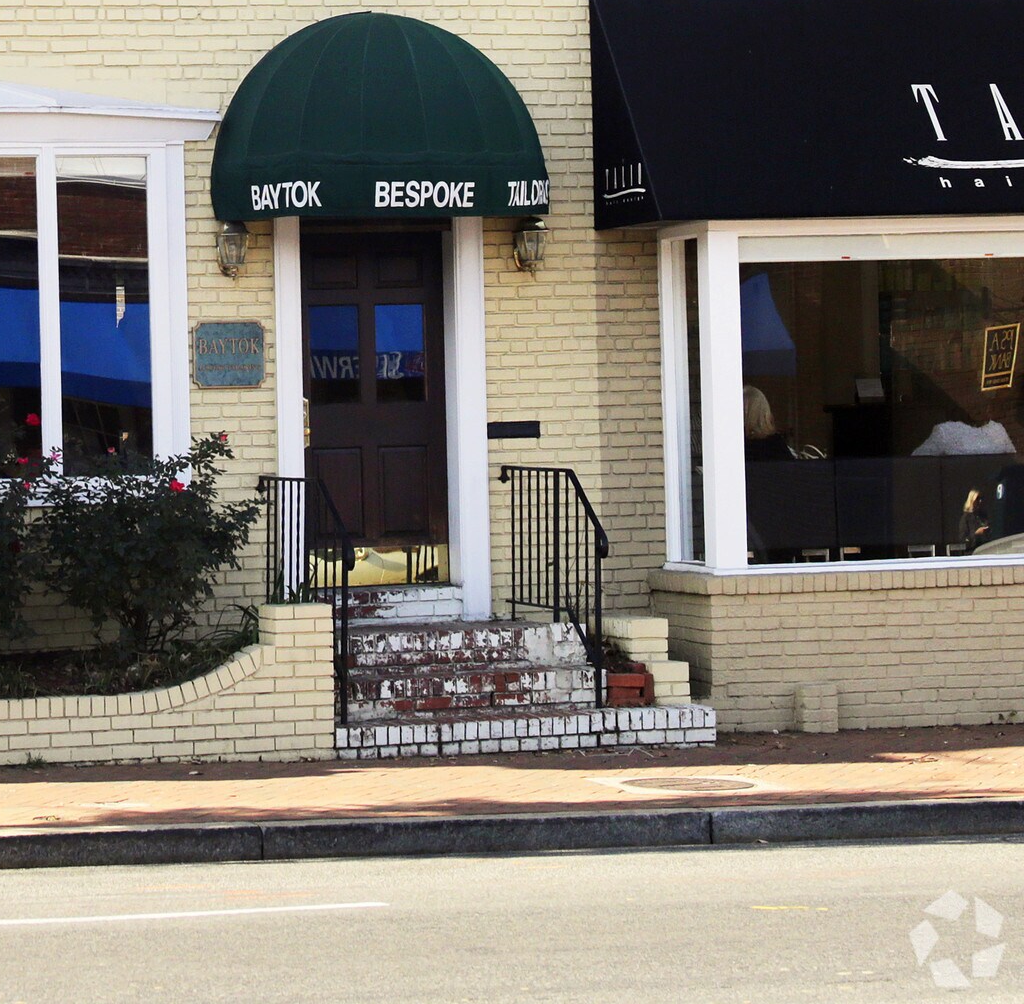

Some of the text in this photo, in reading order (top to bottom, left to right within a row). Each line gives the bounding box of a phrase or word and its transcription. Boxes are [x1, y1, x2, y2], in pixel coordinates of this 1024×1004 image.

[251, 180, 322, 211] BAYTOK
[375, 180, 476, 208] BESPOKE
[199, 337, 260, 355] BAYTOK
